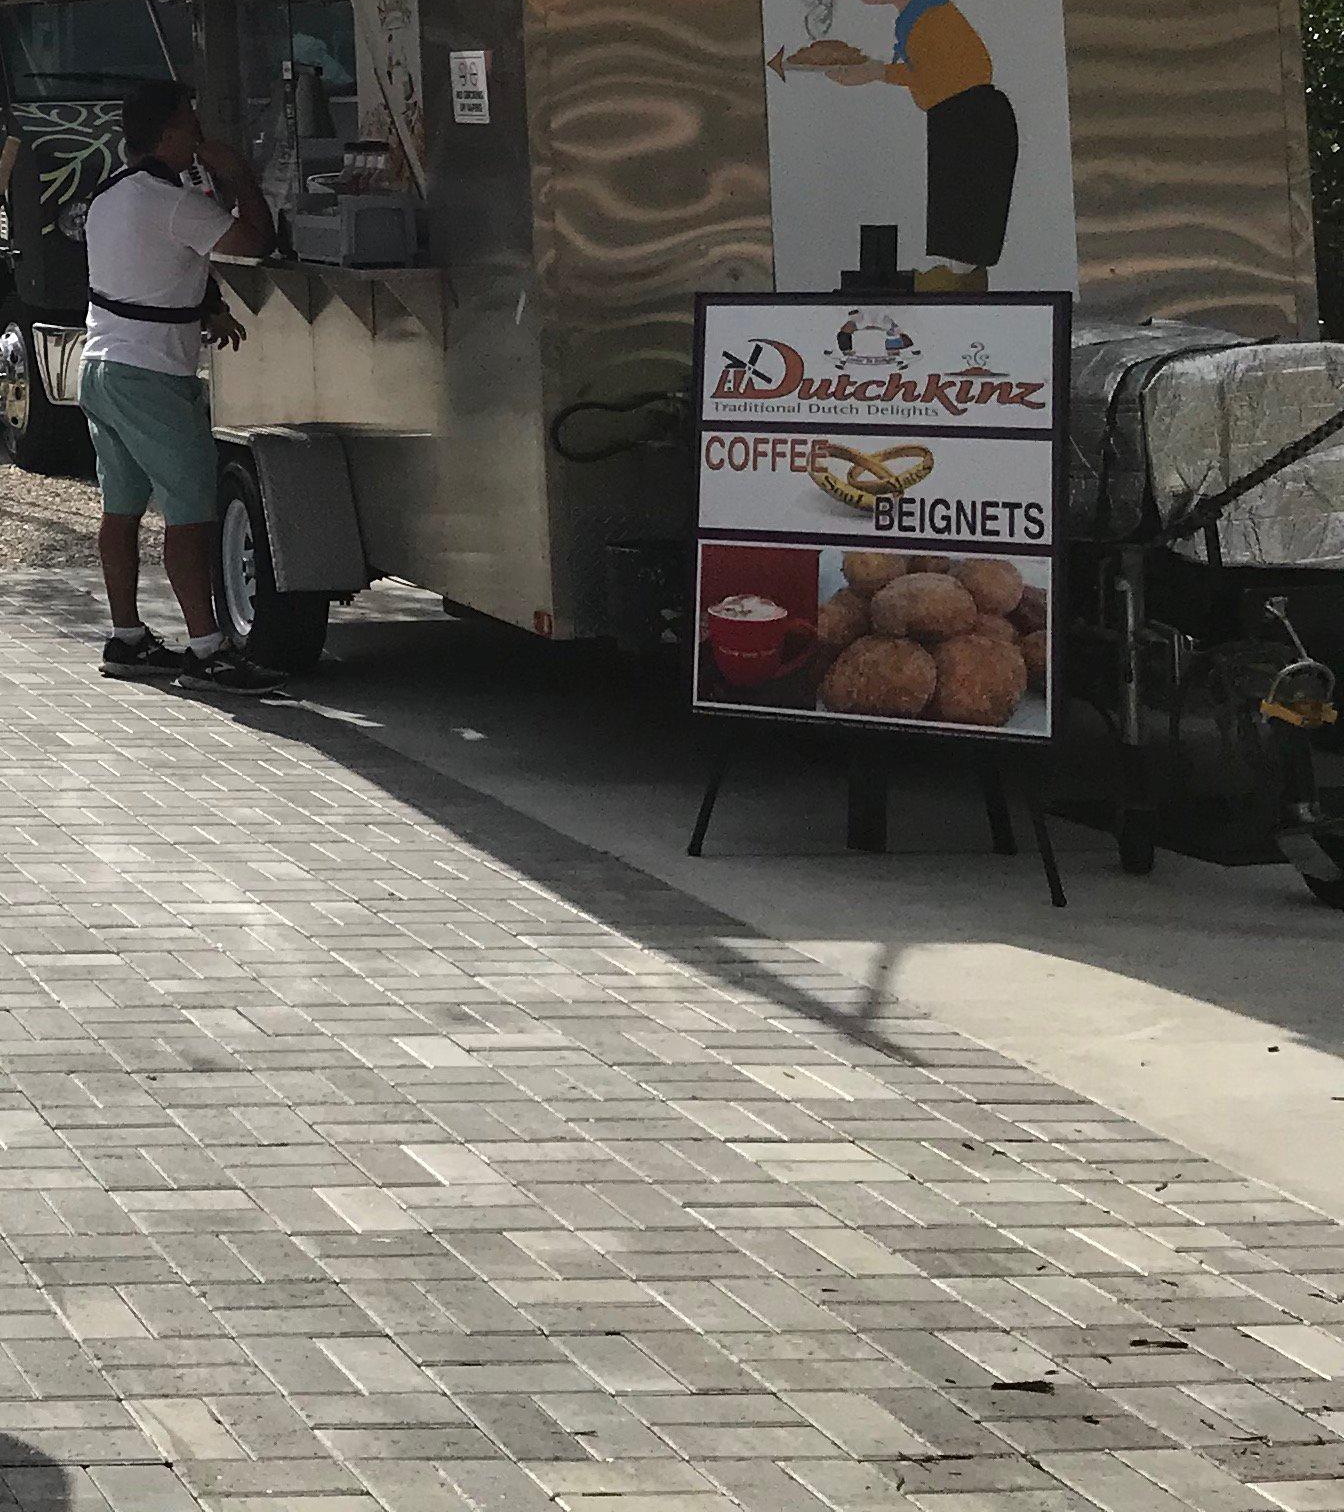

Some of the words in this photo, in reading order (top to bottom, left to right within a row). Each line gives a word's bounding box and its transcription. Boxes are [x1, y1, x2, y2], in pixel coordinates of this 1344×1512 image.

[710, 338, 1047, 417] Dutchkinz
[713, 400, 801, 414] Traditional
[808, 402, 860, 416] Dutch
[866, 404, 939, 418] Delights
[704, 435, 830, 473] COFFEE
[873, 496, 1046, 540] BEIGNETS
